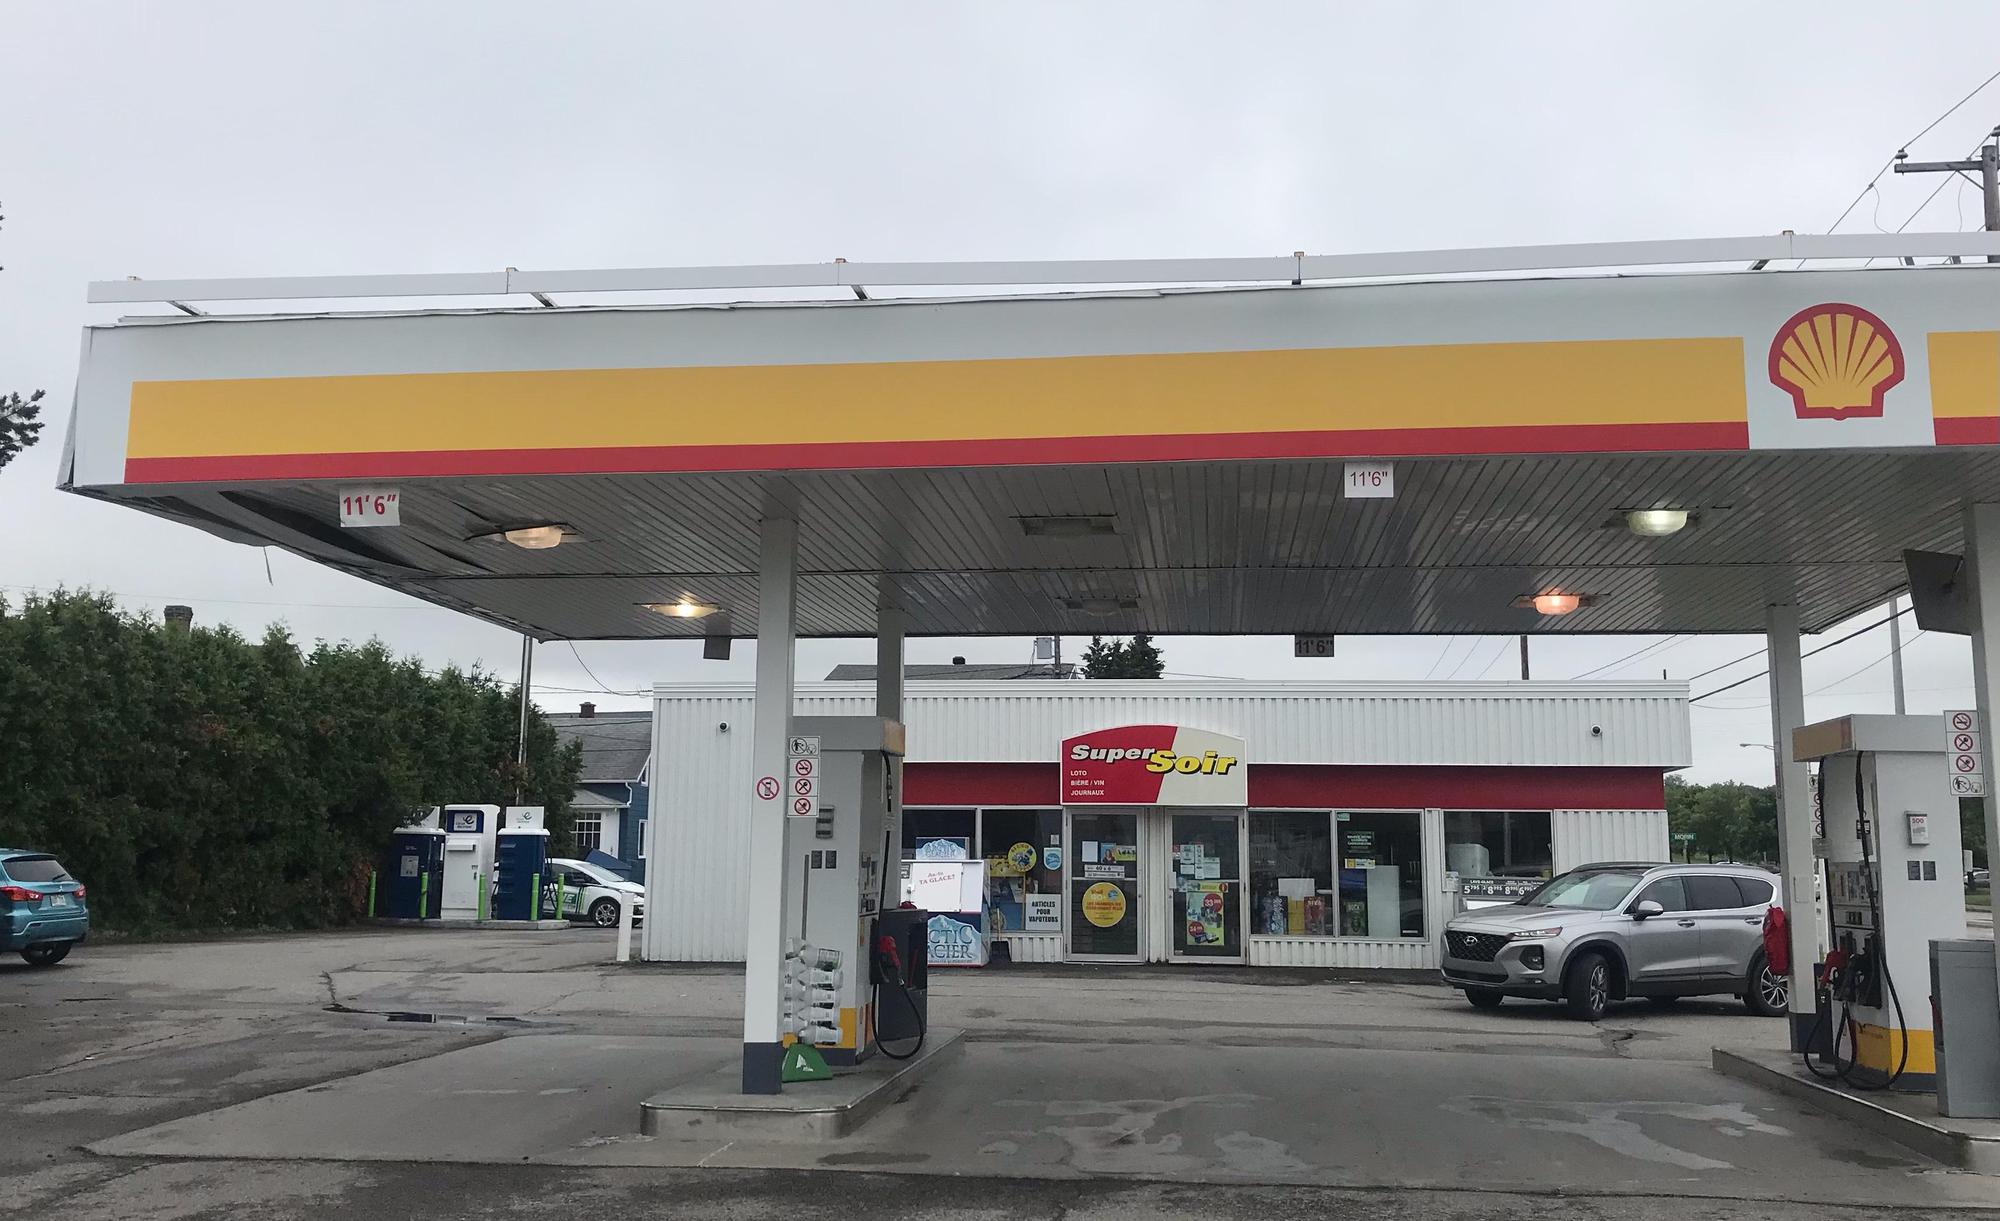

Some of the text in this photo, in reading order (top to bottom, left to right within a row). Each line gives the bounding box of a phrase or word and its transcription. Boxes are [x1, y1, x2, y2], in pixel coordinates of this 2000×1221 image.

[1349, 471, 1388, 487] 11'6"
[1070, 744, 1237, 775] Super Soir
[1070, 769, 1088, 777] LOTO
[927, 925, 973, 945] CTIC
